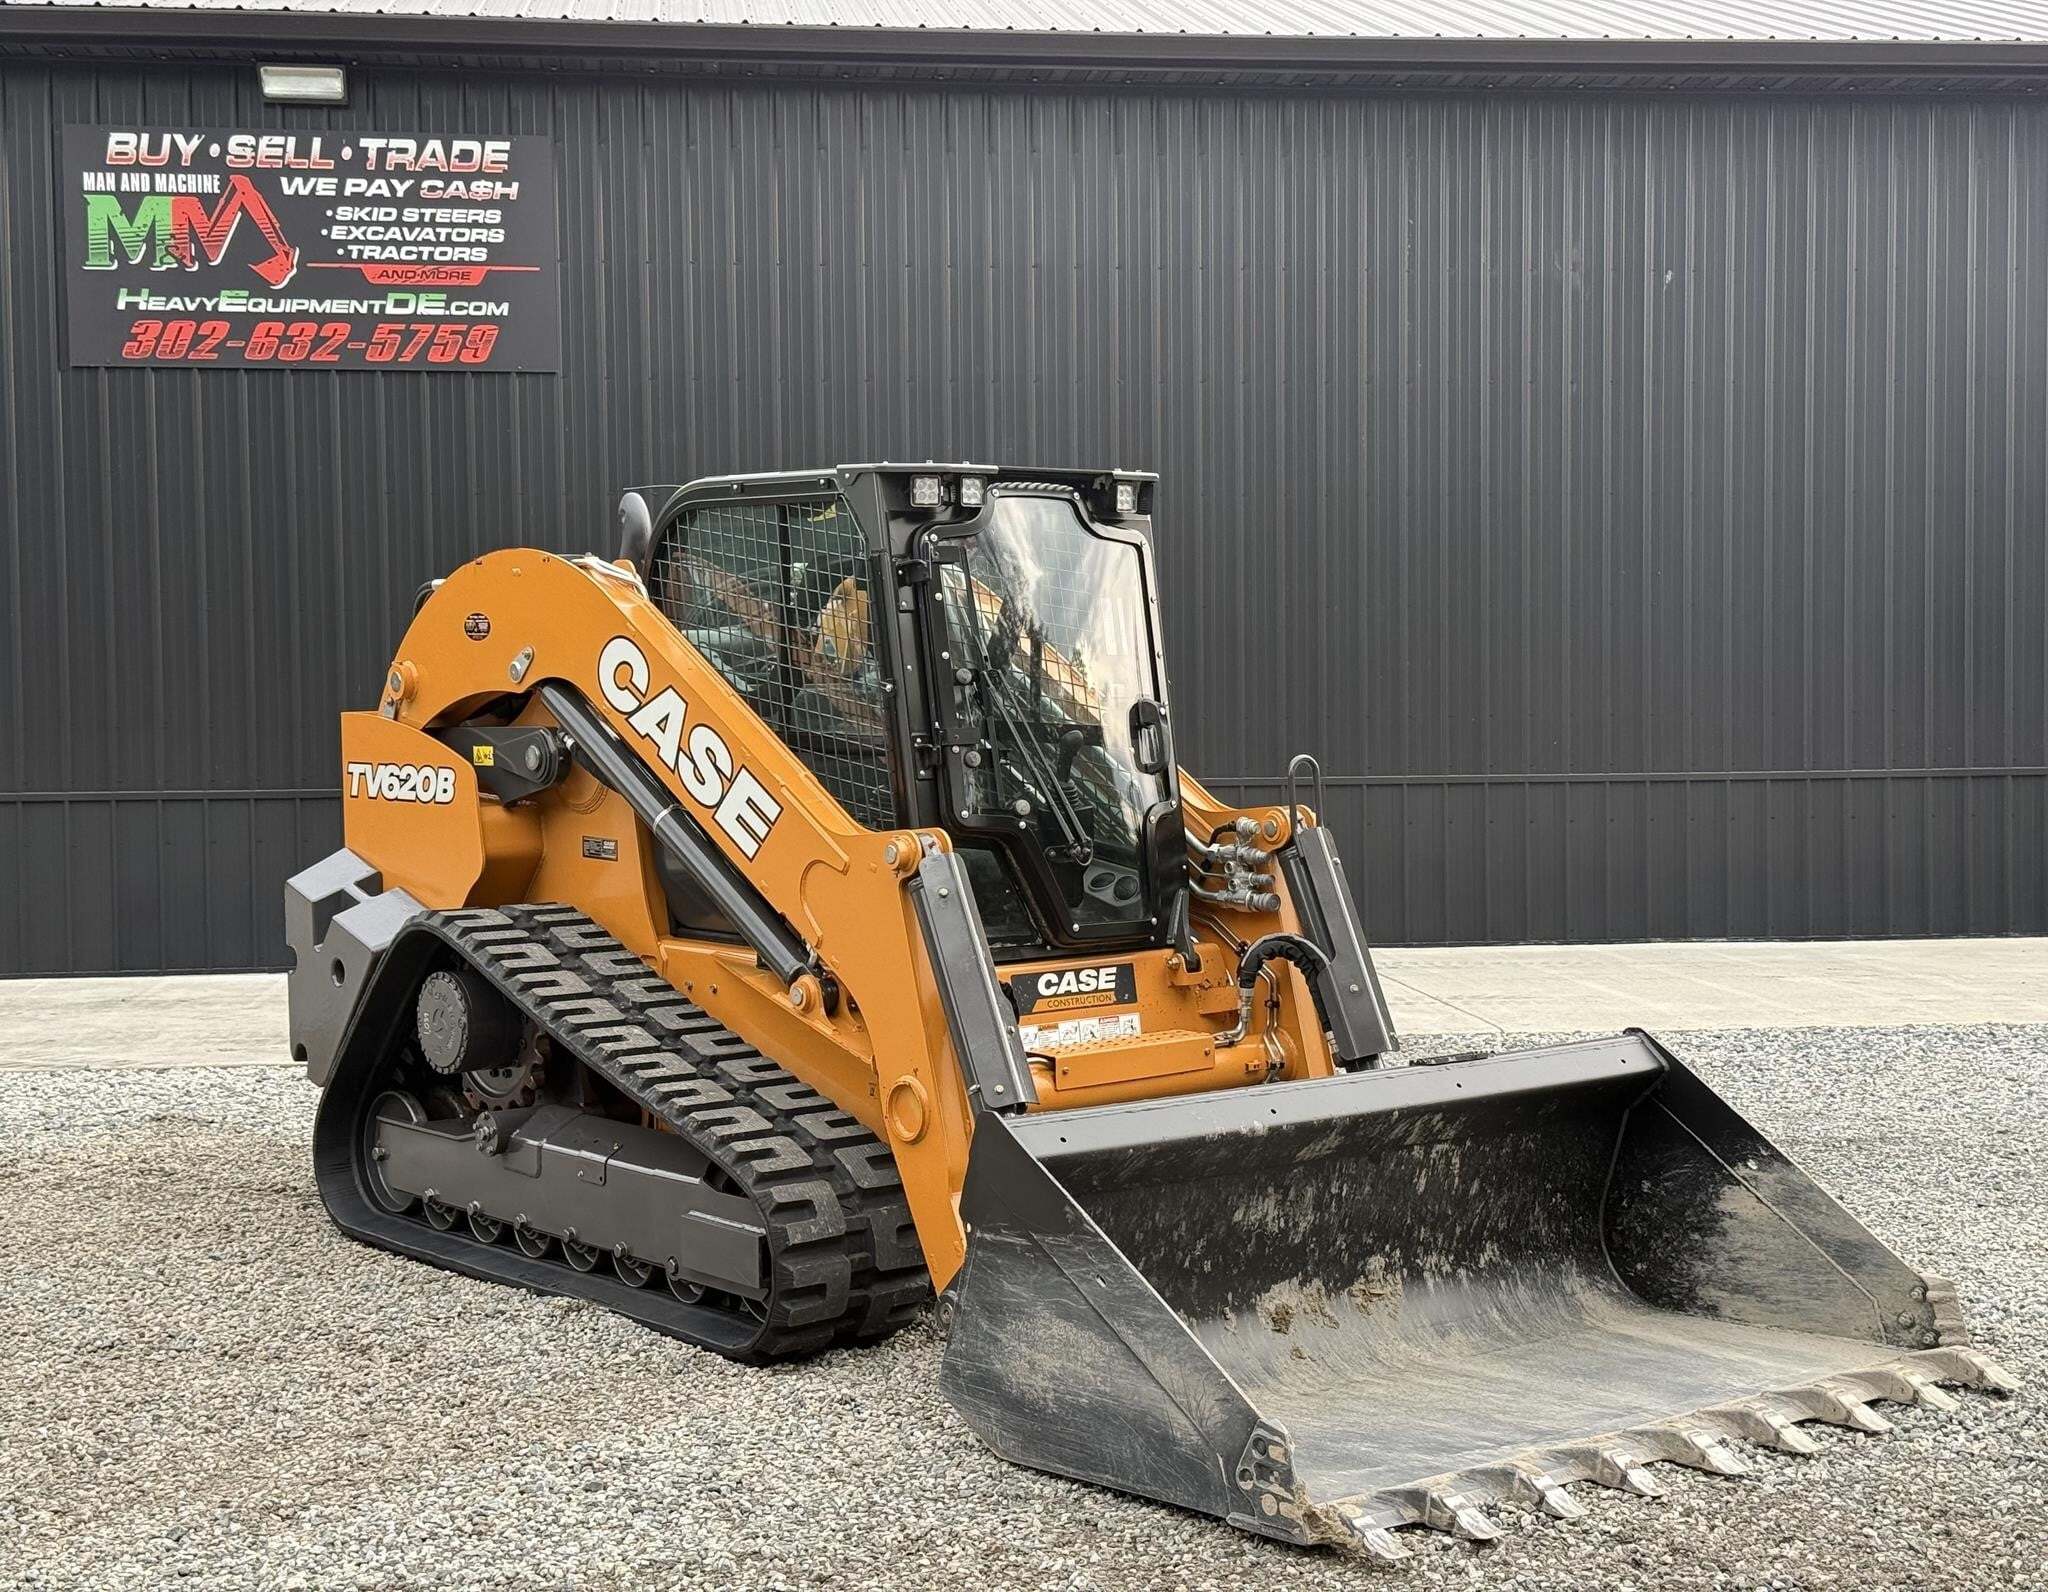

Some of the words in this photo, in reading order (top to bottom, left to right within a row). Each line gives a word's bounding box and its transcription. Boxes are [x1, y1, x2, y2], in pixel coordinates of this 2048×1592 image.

[106, 132, 205, 166] BUY
[226, 134, 334, 169] SELL
[359, 137, 511, 173] TRADE
[83, 171, 112, 191] MAN
[120, 172, 150, 192] AND
[155, 173, 221, 194] MACHINE
[280, 176, 338, 196] WE
[344, 178, 414, 197] PAY
[420, 180, 519, 201] CA$H
[335, 206, 397, 222] SKID
[402, 207, 502, 224] STEERS
[330, 225, 505, 243] EXCAVATORS
[347, 244, 488, 262] TRACTORS
[116, 288, 509, 317] HEAVYEQUIPMENTDE.COM
[121, 319, 500, 364] 302-632-5759
[598, 635, 784, 862] CASE
[347, 762, 456, 804] TV620B
[1037, 966, 1117, 997] CASE
[1047, 993, 1112, 1009] CONSTRUCTION
